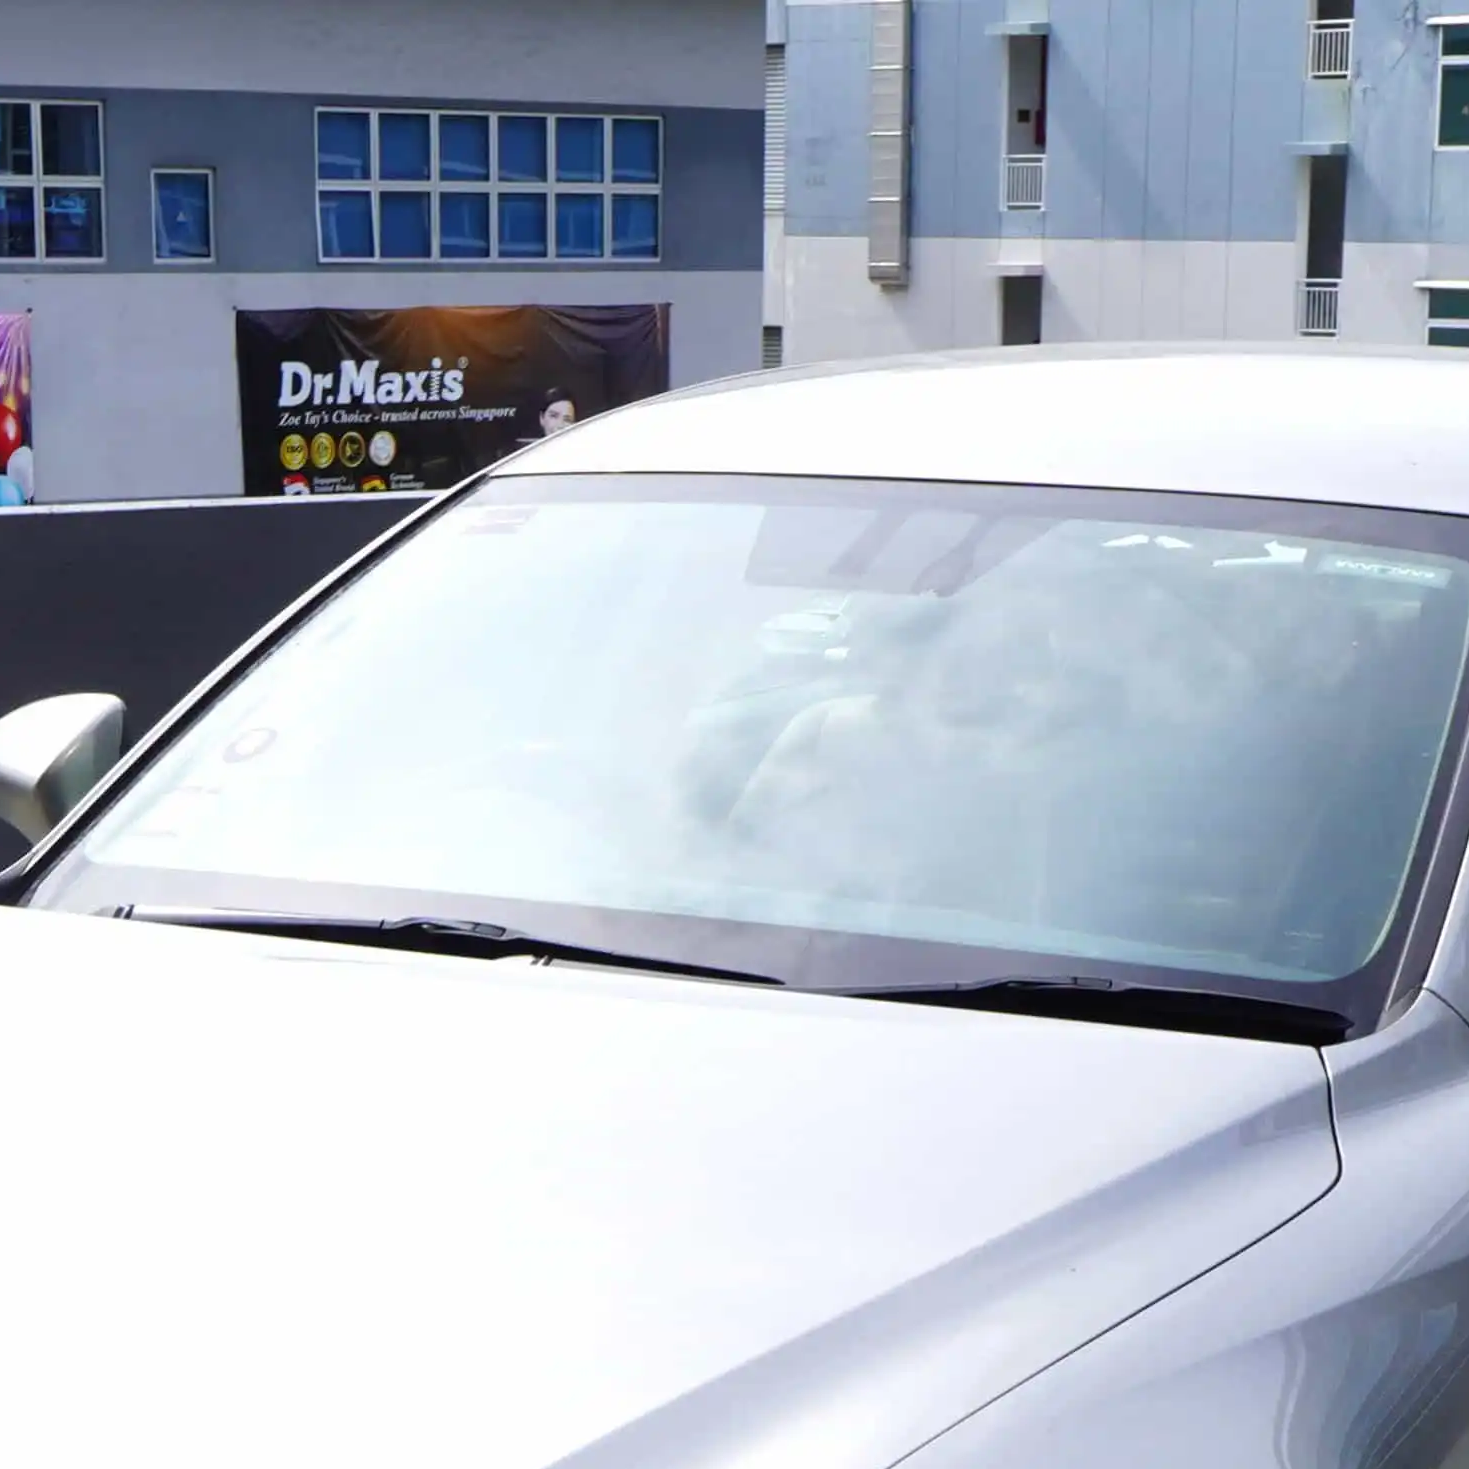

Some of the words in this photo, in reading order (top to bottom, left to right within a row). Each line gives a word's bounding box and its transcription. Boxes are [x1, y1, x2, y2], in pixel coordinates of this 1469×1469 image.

[278, 412, 301, 427] Zoe
[304, 410, 328, 428] Tay's
[332, 409, 371, 425] Choice
[381, 408, 418, 422] trusted
[420, 409, 456, 421] across
[459, 405, 516, 422] Singapore
